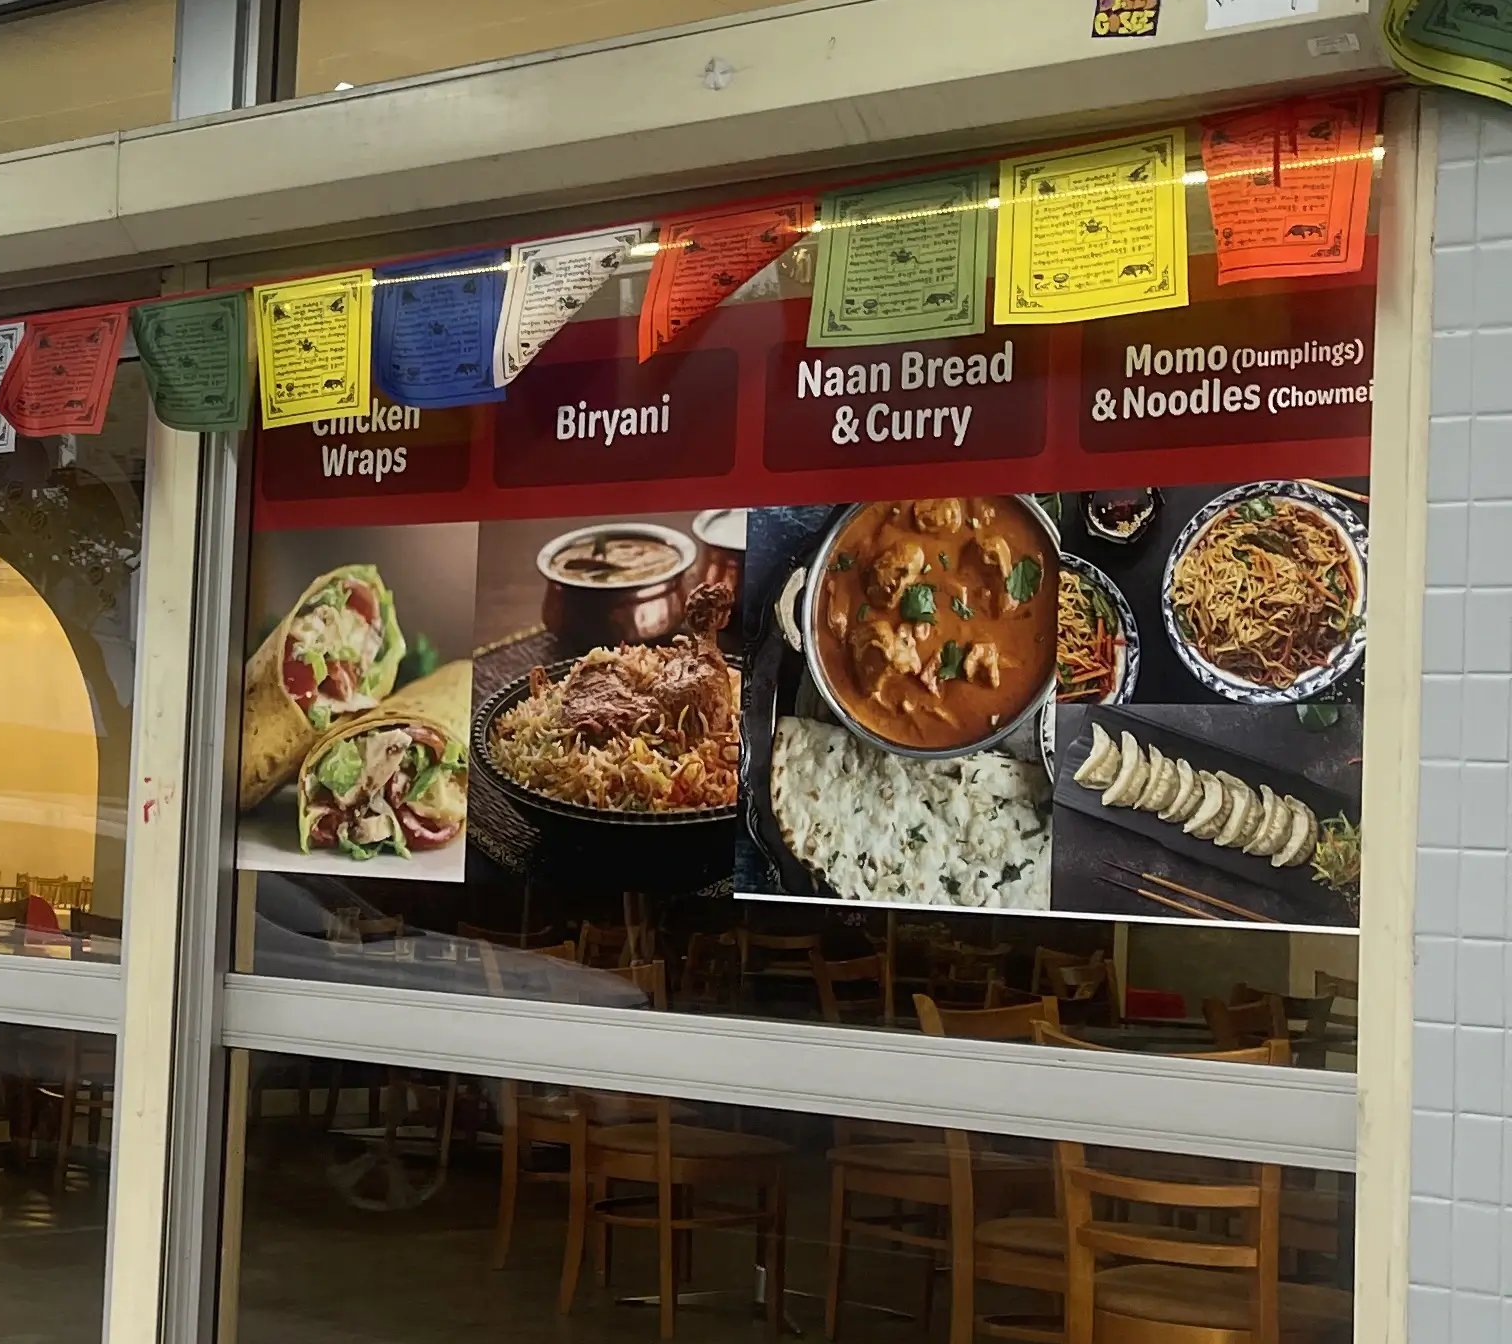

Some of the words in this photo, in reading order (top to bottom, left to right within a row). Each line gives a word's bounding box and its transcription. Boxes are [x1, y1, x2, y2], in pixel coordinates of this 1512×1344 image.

[797, 359, 890, 398] Naan
[900, 341, 1014, 391] Bread
[1125, 343, 1228, 378] Momo
[1232, 338, 1364, 374] (Dumplings)
[555, 394, 671, 446] Biryani
[1091, 387, 1118, 422] &
[1122, 377, 1262, 419] Noodles
[831, 405, 861, 446] &
[865, 403, 973, 447] Curry
[321, 443, 408, 483] Wraps
